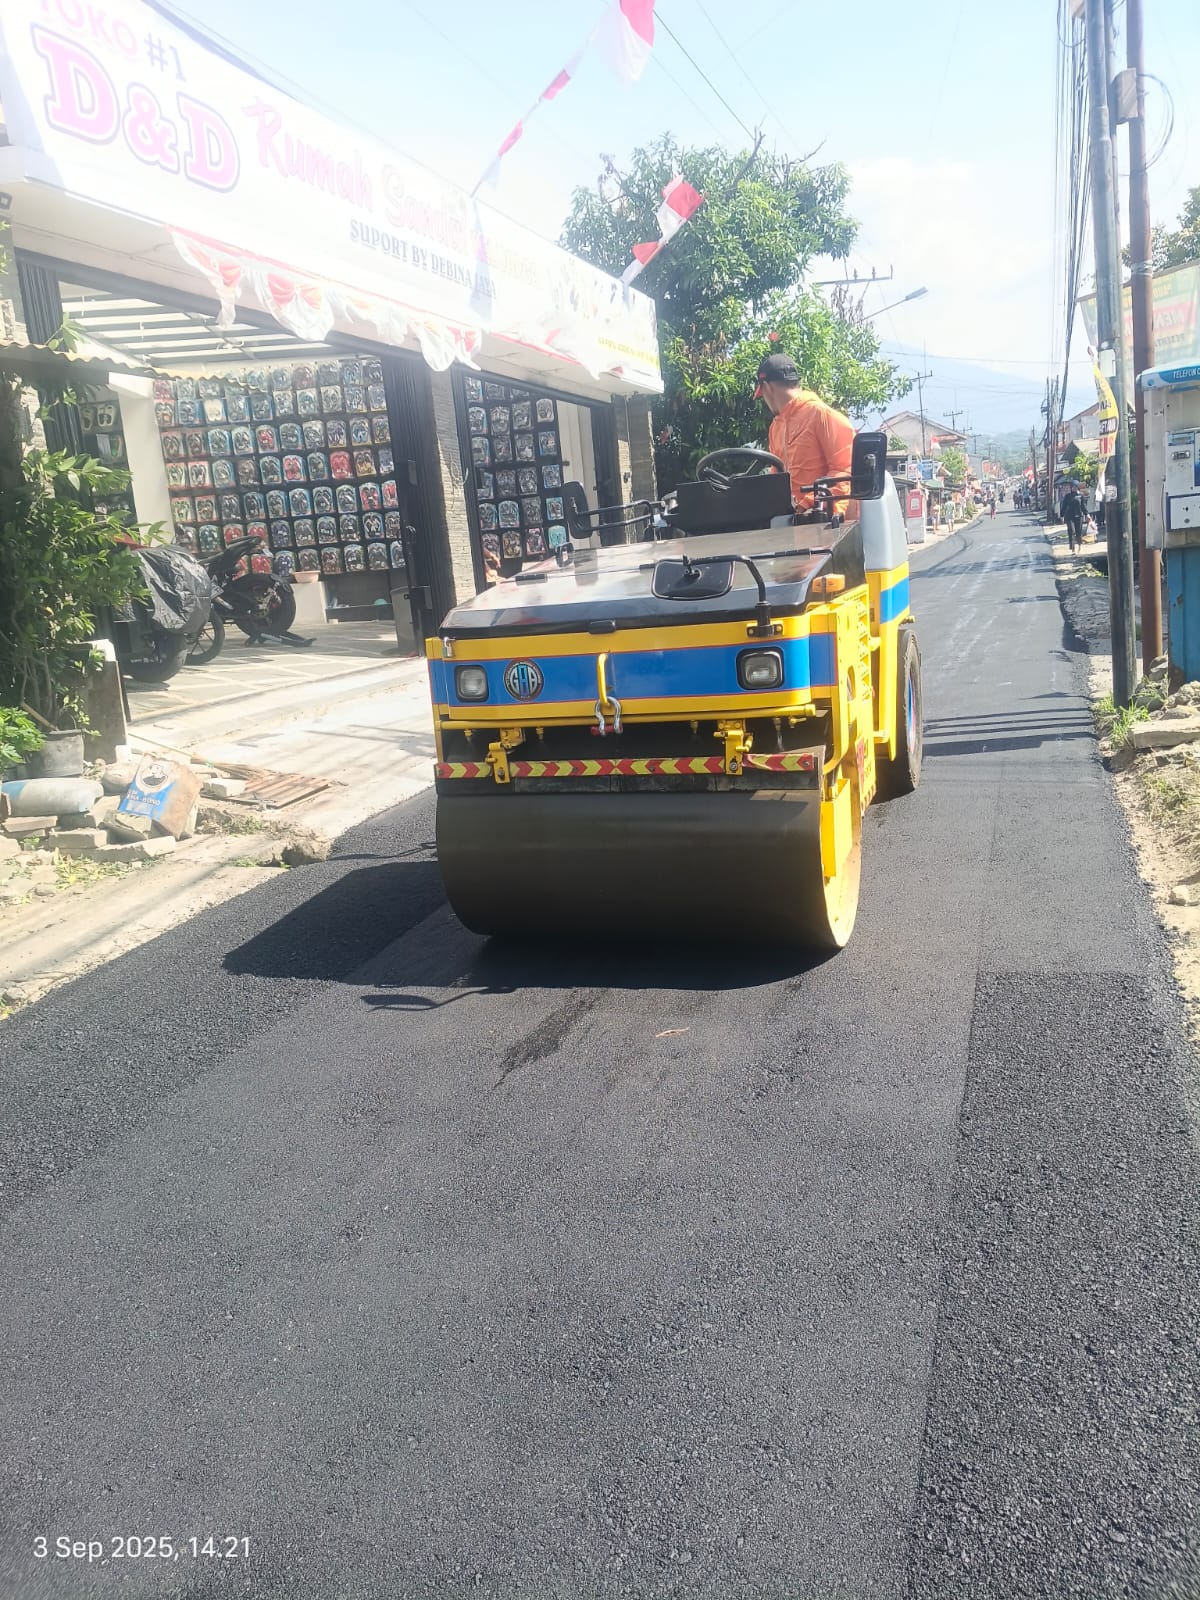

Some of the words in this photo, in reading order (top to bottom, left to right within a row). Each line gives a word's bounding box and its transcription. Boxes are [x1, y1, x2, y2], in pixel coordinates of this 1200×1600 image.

[144, 32, 187, 84] #1
[30, 22, 241, 194] D&D
[241, 96, 374, 213] Rumah
[350, 218, 409, 263] SUPORT
[411, 244, 428, 272] BY
[431, 253, 472, 289] DEBINA
